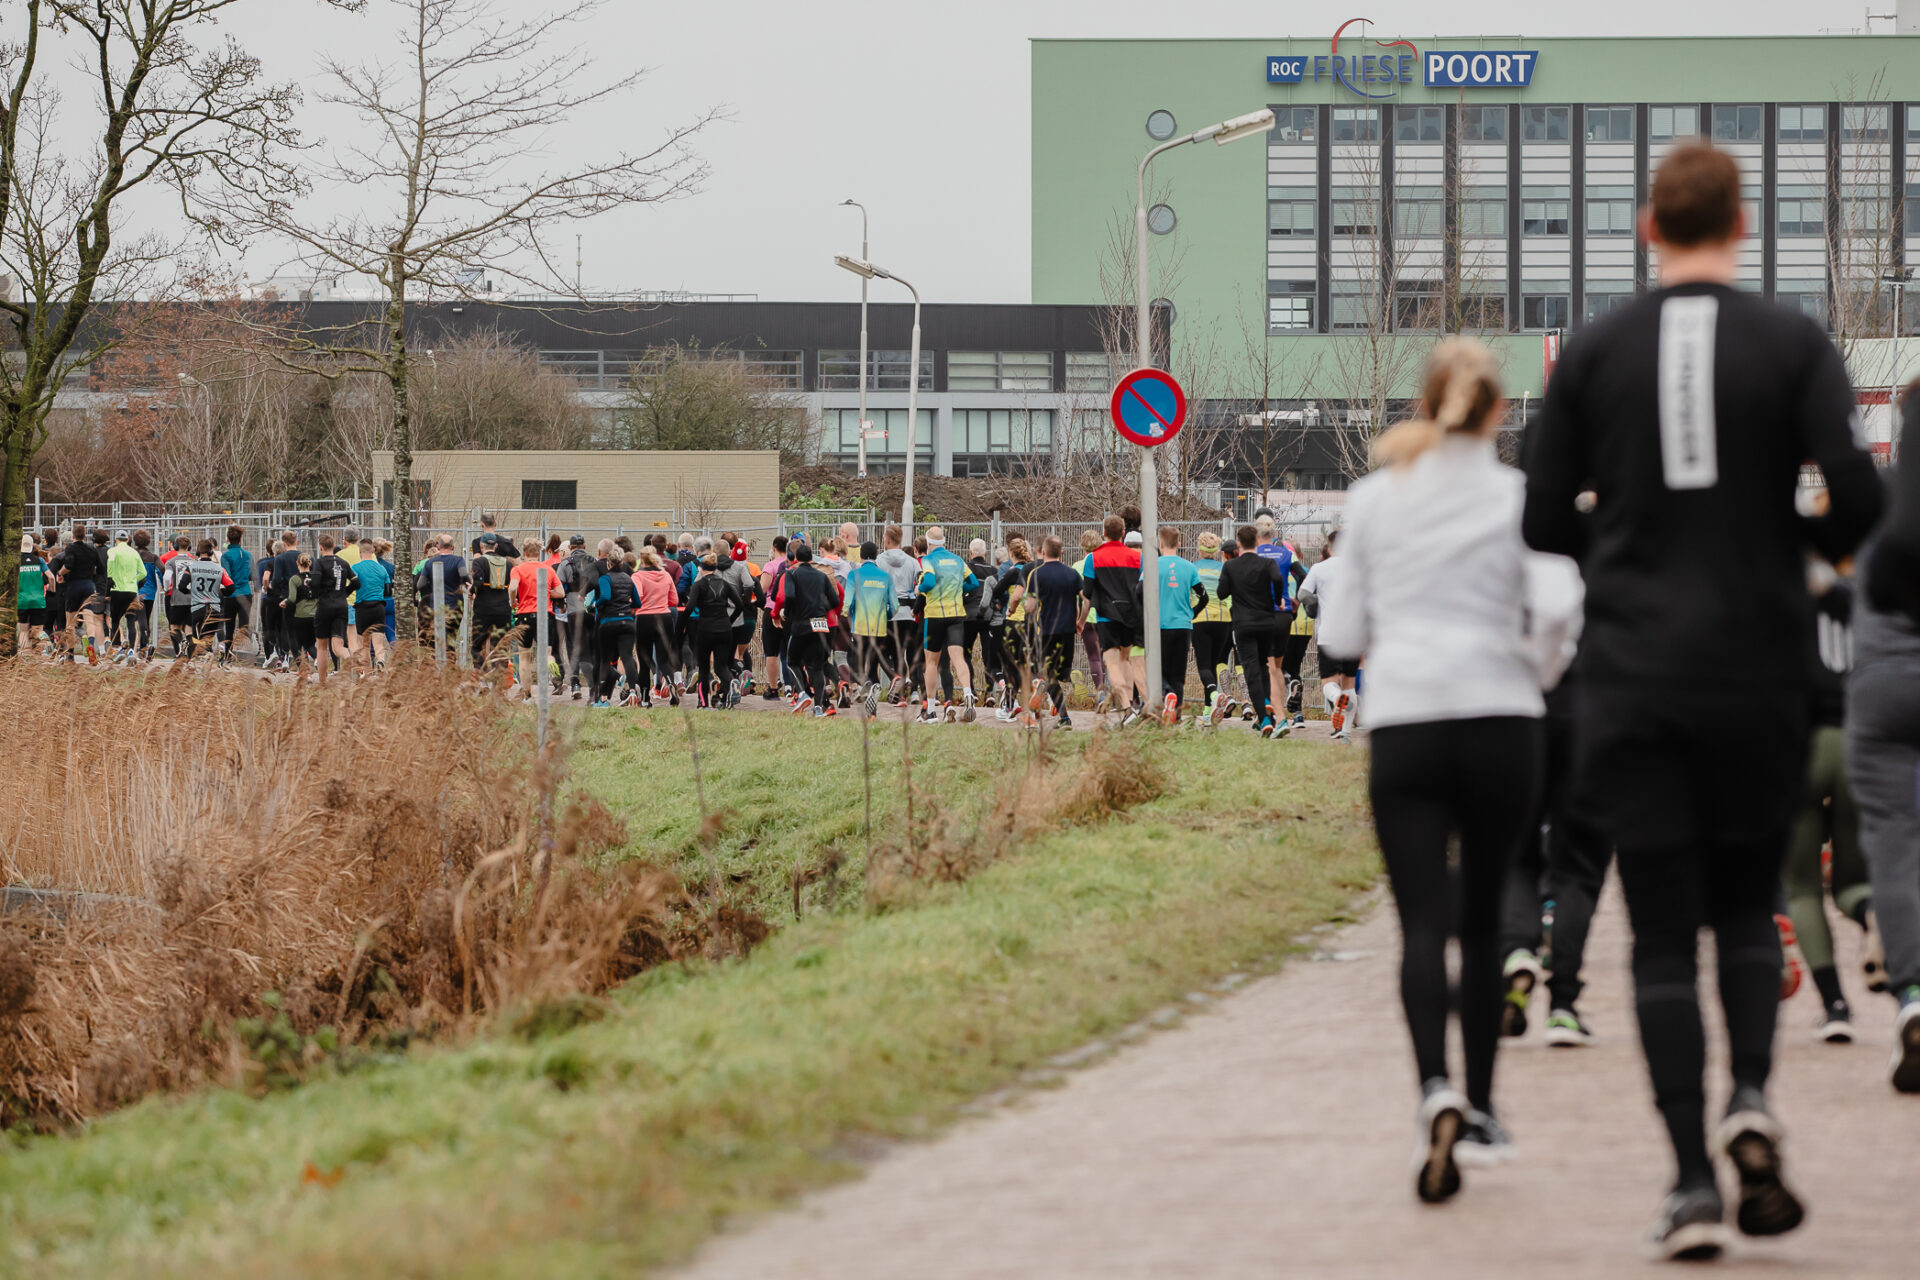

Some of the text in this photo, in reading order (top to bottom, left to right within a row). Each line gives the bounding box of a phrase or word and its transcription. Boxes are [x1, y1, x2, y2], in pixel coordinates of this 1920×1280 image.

[1271, 53, 1531, 83] ROC FRIESE POORT
[196, 576, 217, 592] 37
